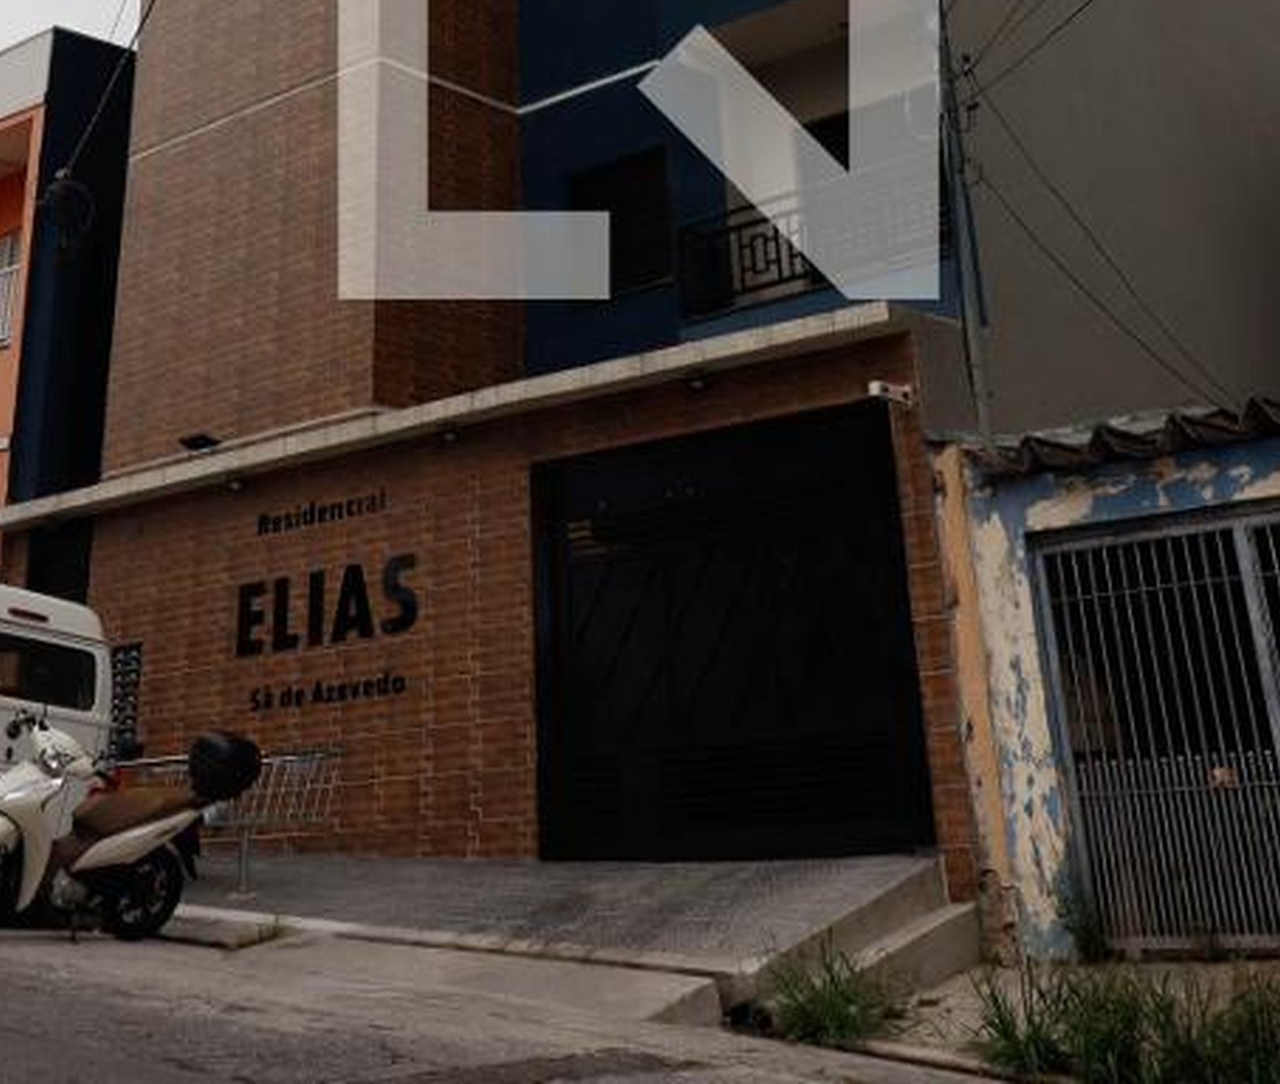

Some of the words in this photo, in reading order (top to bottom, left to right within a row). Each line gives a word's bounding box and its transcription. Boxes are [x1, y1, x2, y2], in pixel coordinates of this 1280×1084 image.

[257, 487, 387, 536] Residencial
[236, 553, 418, 657] ELIAS
[279, 684, 305, 708] de
[311, 671, 407, 704] Azevedo
